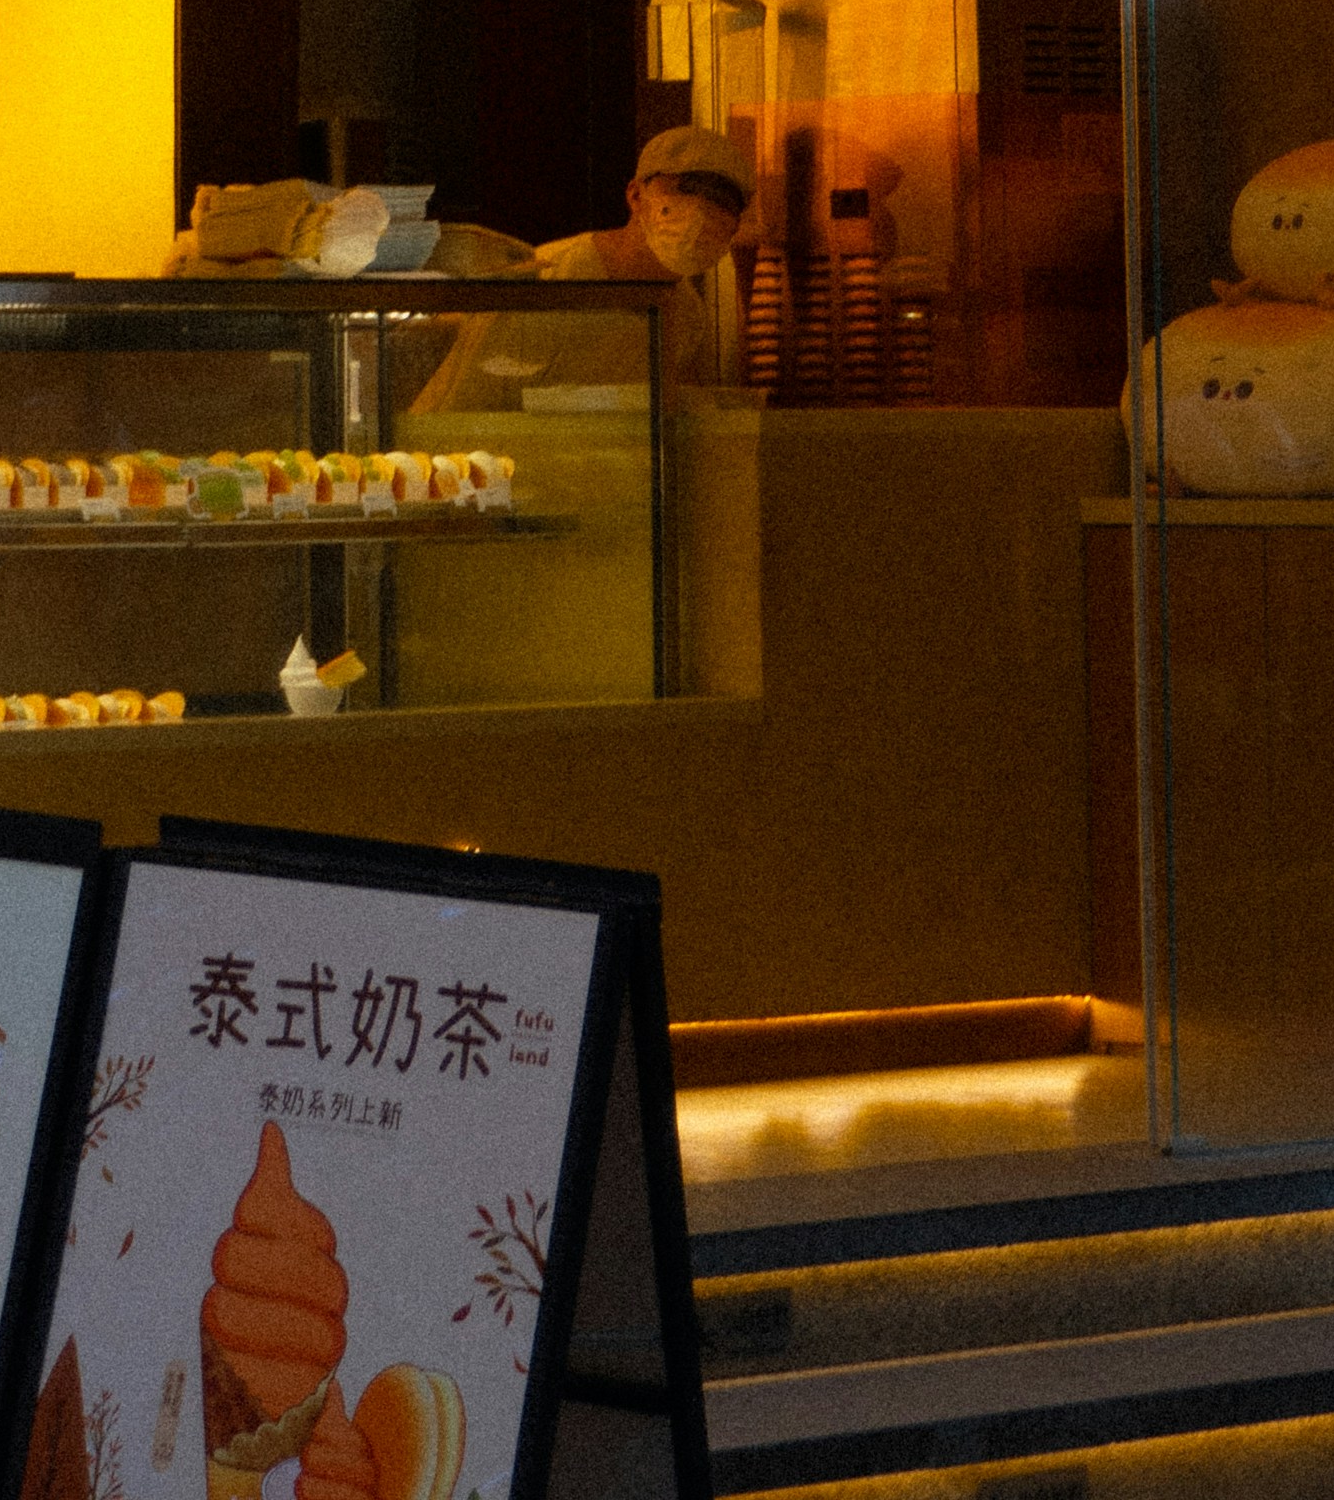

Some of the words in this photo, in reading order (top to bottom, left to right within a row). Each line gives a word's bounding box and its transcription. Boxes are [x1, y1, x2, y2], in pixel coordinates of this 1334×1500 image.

[188, 952, 508, 1081] 泰式奶茶
[515, 1007, 555, 1031] fufu
[509, 1043, 550, 1067] land
[259, 1083, 404, 1131] 泰奶系列上新
